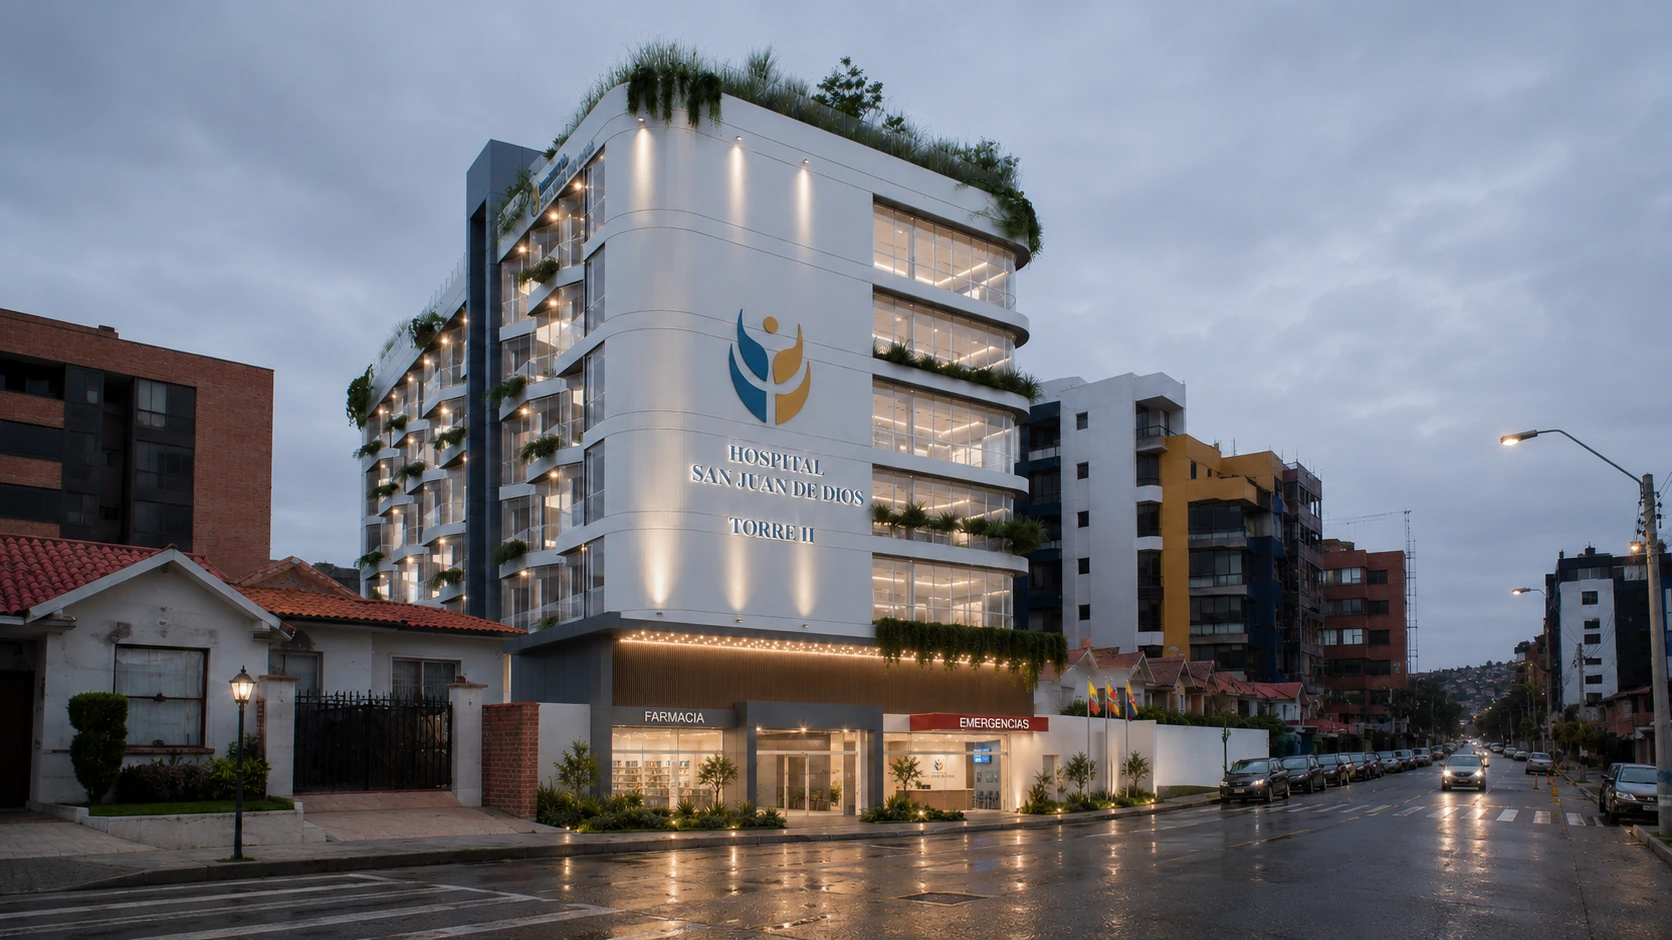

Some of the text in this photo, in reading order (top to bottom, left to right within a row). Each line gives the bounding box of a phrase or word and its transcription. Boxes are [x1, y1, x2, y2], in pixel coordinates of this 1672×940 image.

[728, 445, 824, 477] HOSPITAL
[691, 464, 864, 507] SAN JUAN DE DIOS
[728, 517, 815, 543] TORRE II
[644, 711, 705, 723] FARMACIA
[959, 717, 1029, 729] EMERGENCIAS
